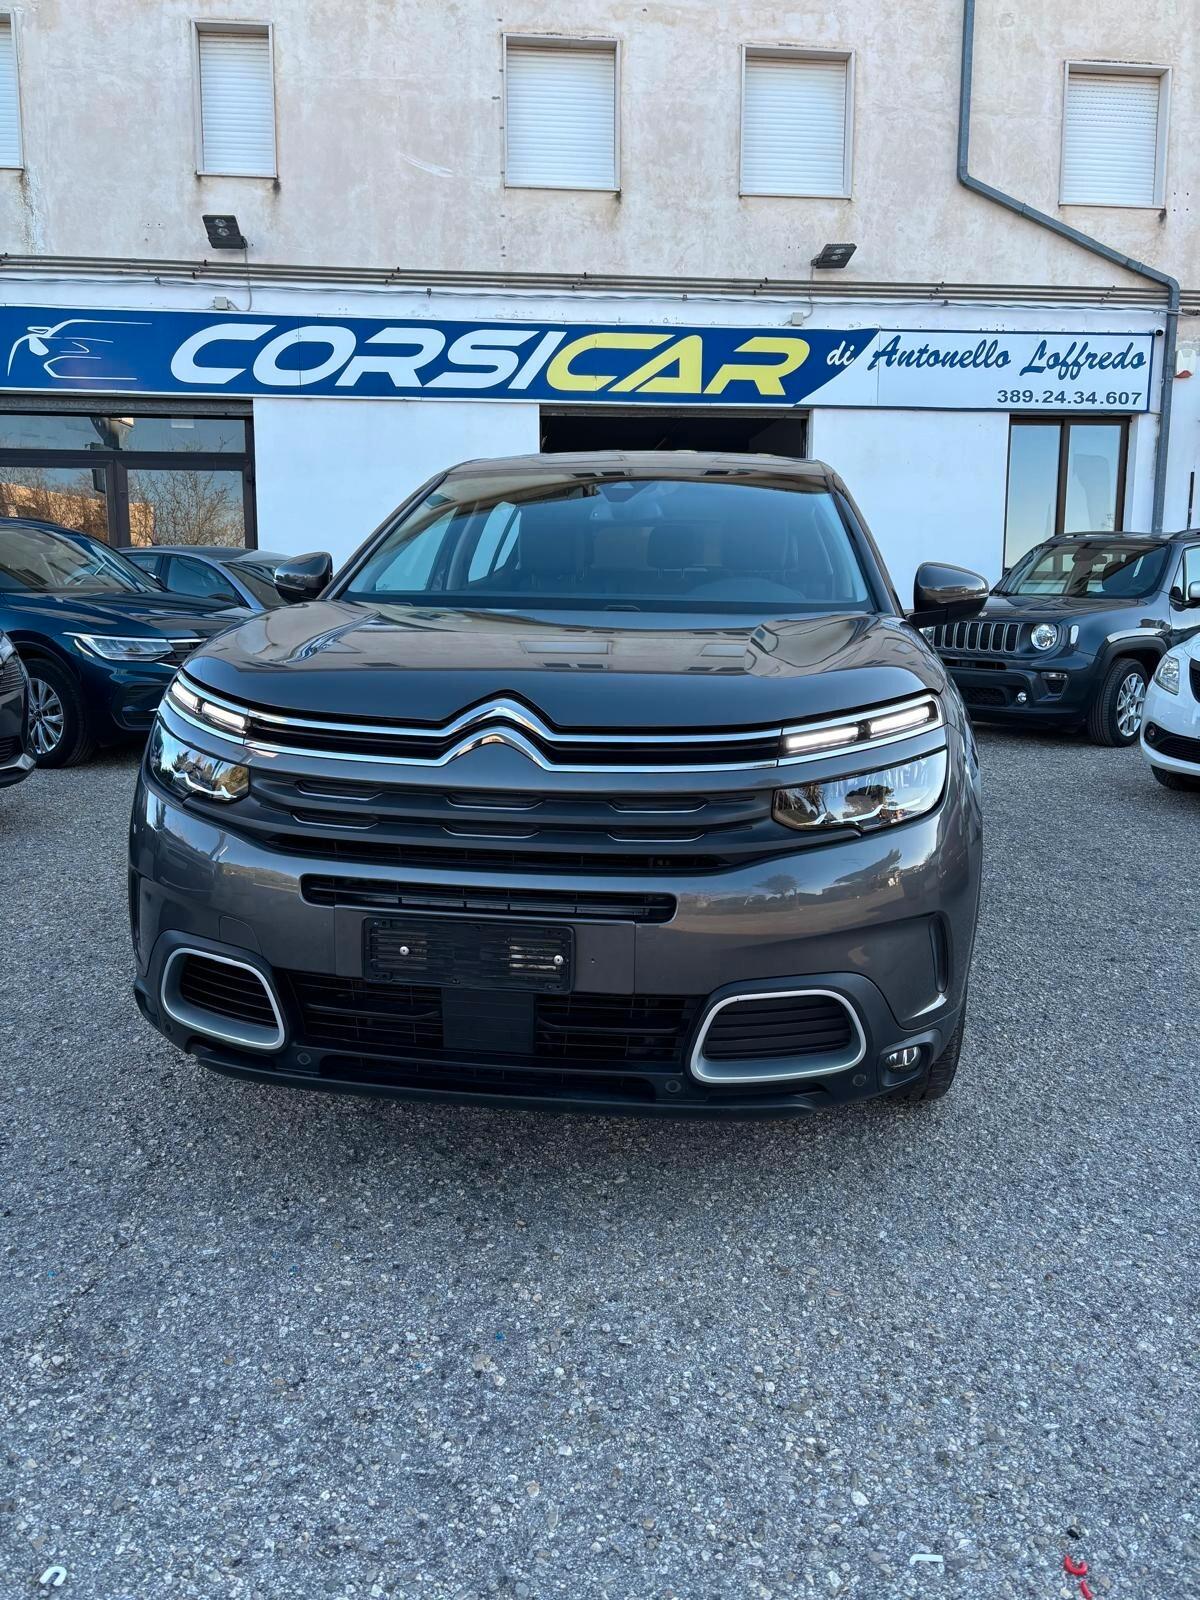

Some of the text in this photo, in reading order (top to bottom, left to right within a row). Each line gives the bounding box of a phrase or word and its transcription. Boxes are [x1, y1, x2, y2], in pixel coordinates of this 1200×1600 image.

[826, 340, 855, 366] di
[867, 334, 1012, 371] Antonello
[1019, 340, 1147, 381] Loffredo
[996, 389, 1143, 406] 389.24.34.607
